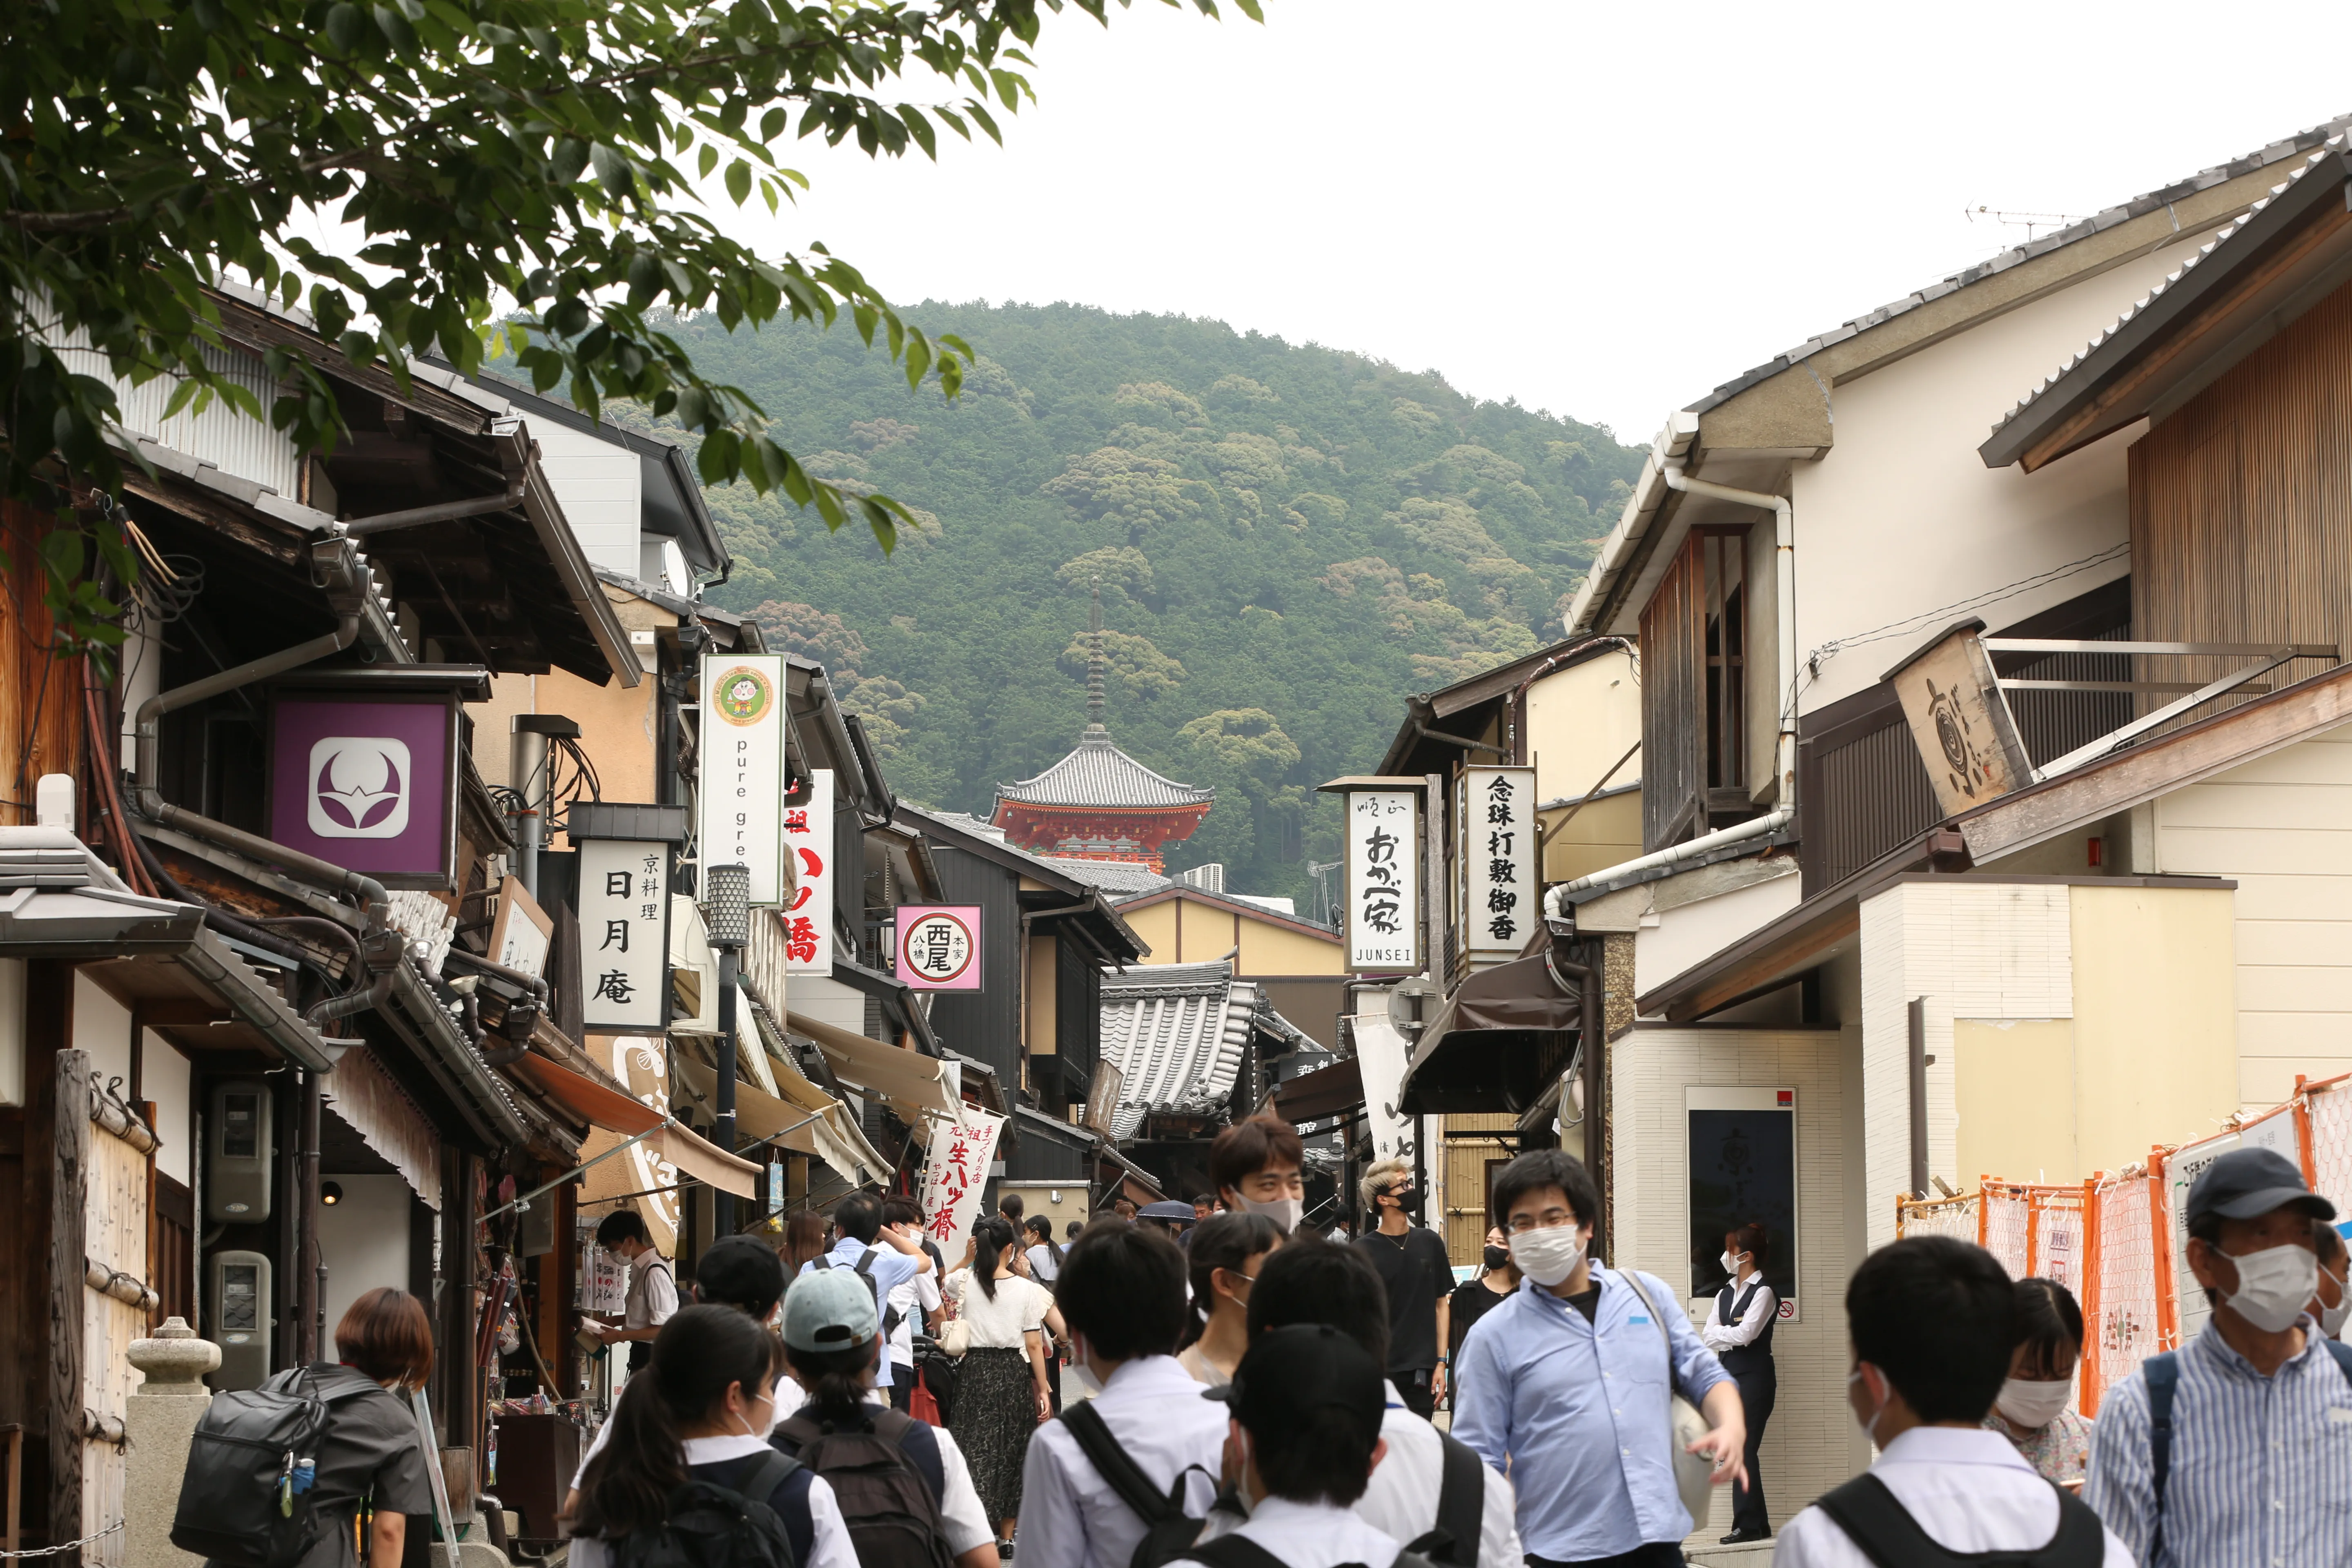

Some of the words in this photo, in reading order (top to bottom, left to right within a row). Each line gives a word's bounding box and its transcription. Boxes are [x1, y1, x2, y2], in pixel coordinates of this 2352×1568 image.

[715, 675, 729, 695] Maccha
[751, 671, 764, 682] serve
[737, 740, 747, 797] pure
[641, 854, 659, 920] 京料理
[1363, 826, 1402, 935] おかべ家
[592, 871, 637, 1004] 日月庵
[913, 935, 926, 959] 八ツ橋
[923, 924, 952, 971] 西尾
[952, 935, 964, 959] 本家
[1356, 949, 1411, 961] JUNSEI
[969, 1125, 993, 1184] 手づくりの店
[924, 1163, 942, 1207] やつはし屋
[928, 1140, 970, 1243] 生八ツ橋
